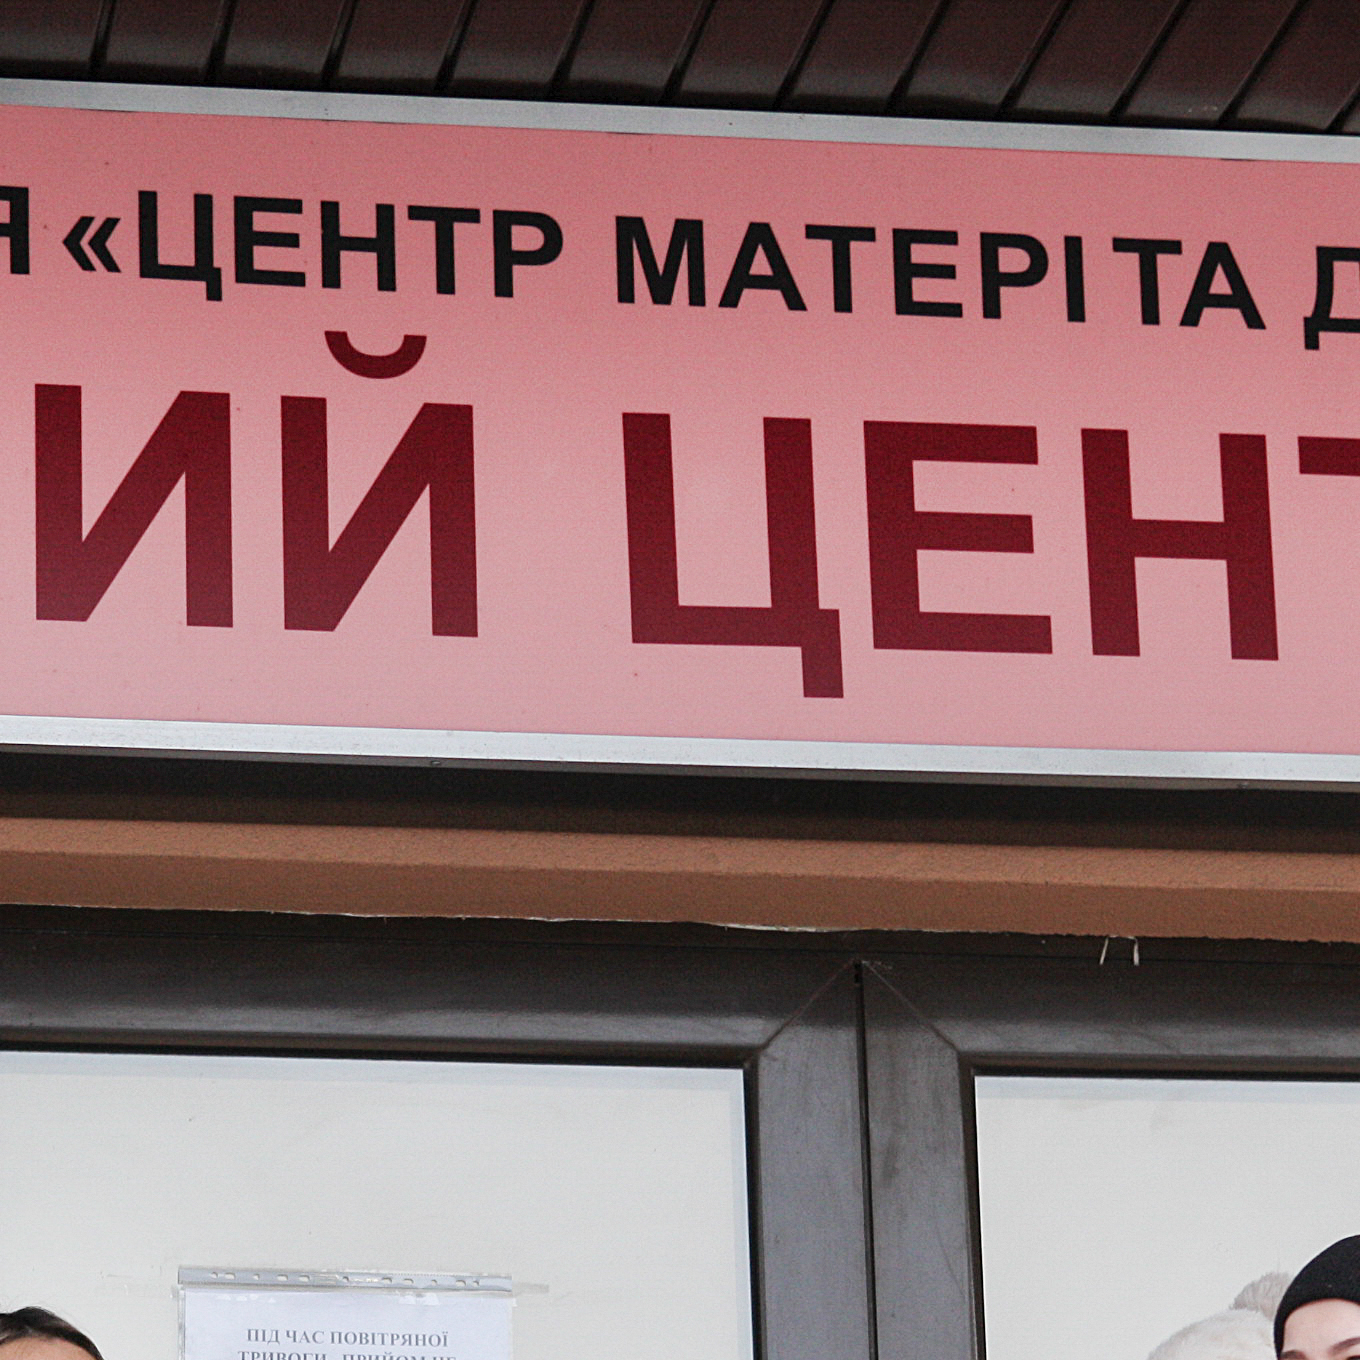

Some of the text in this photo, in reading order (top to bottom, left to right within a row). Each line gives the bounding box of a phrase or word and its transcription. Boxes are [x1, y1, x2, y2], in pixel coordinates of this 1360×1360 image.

[61, 189, 565, 302] «ЦЕНТР
[614, 214, 1087, 324] МАТЕРІ
[1111, 236, 1267, 331] ТА
[247, 1328, 449, 1348] ПІД ЧАС ПОВІТРЯНОЇ
